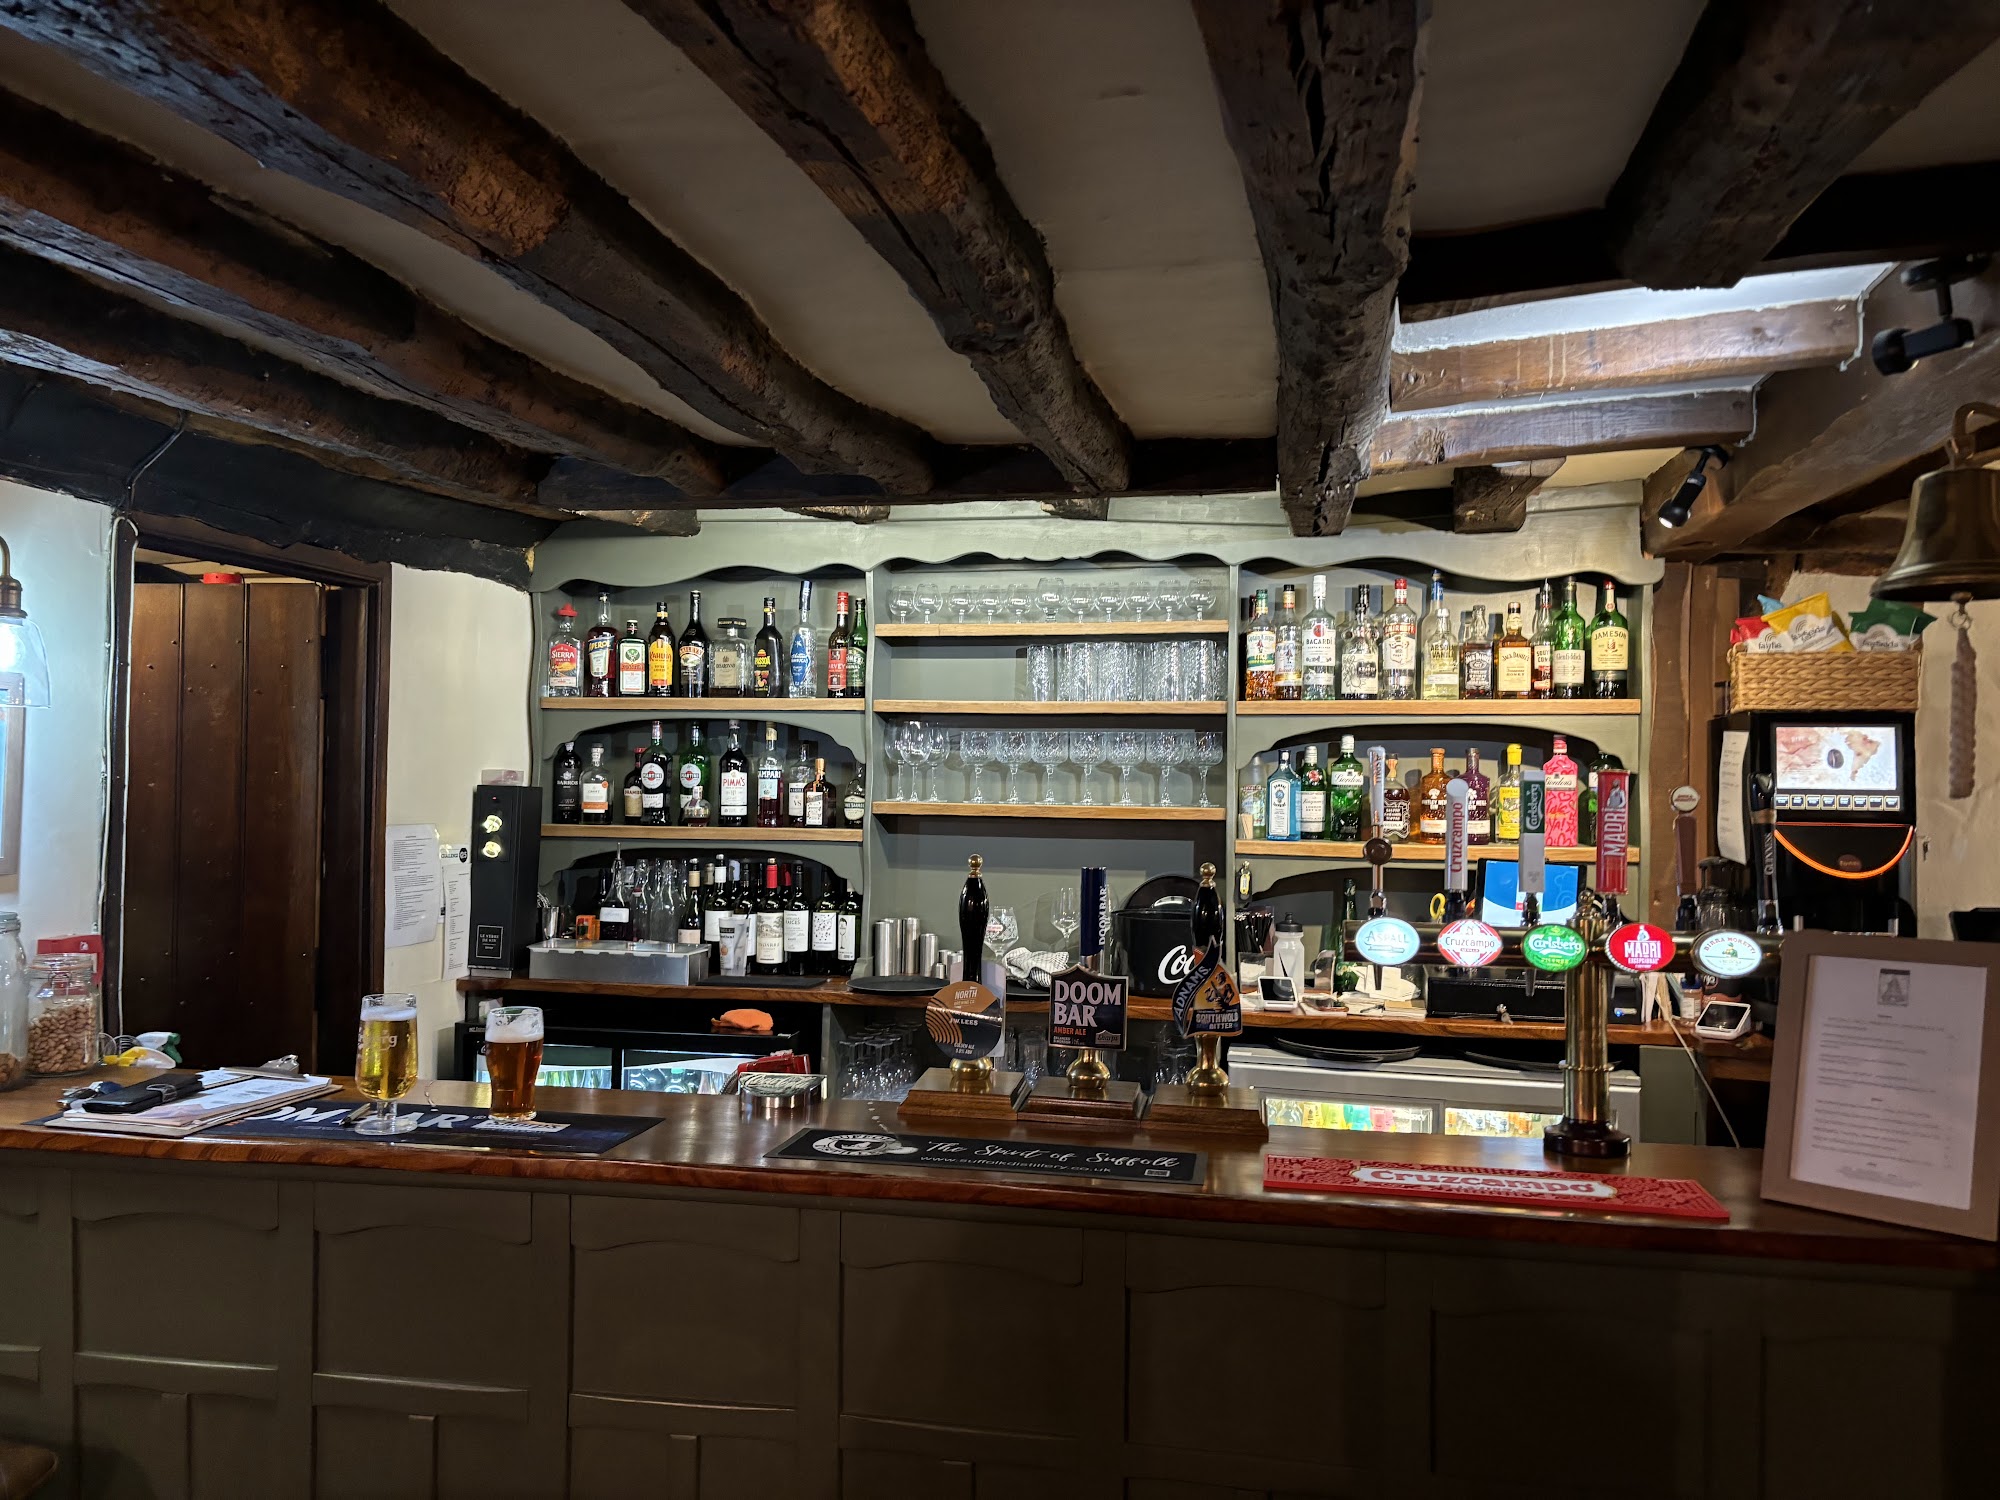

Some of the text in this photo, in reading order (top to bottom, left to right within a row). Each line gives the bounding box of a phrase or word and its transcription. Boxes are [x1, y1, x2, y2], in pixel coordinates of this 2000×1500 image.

[1594, 631, 1627, 641] JAMESON
[588, 640, 611, 651] APEROL
[551, 650, 575, 659] SIERRA
[723, 777, 746, 787] PIMM'S
[1525, 783, 1543, 831] Carlsberg
[1451, 802, 1464, 873] Cruzcampo
[1366, 931, 1409, 945] ASPALL
[1445, 936, 1495, 950] Cruzcampo
[1528, 933, 1582, 955] Carlsberg
[1704, 937, 1757, 955] BIRRA MORETTI
[954, 989, 978, 1000] NORTH
[1054, 980, 1122, 1006] DOOM
[1054, 1003, 1098, 1028] BAR
[1195, 1012, 1239, 1023] SOUTHWOLD
[1054, 1026, 1087, 1036] AMBER ALE
[1209, 1022, 1233, 1030] BITTER
[927, 1142, 1180, 1168] The Spirit of Suffolk
[1370, 1170, 1594, 1194] Cruzcampo
